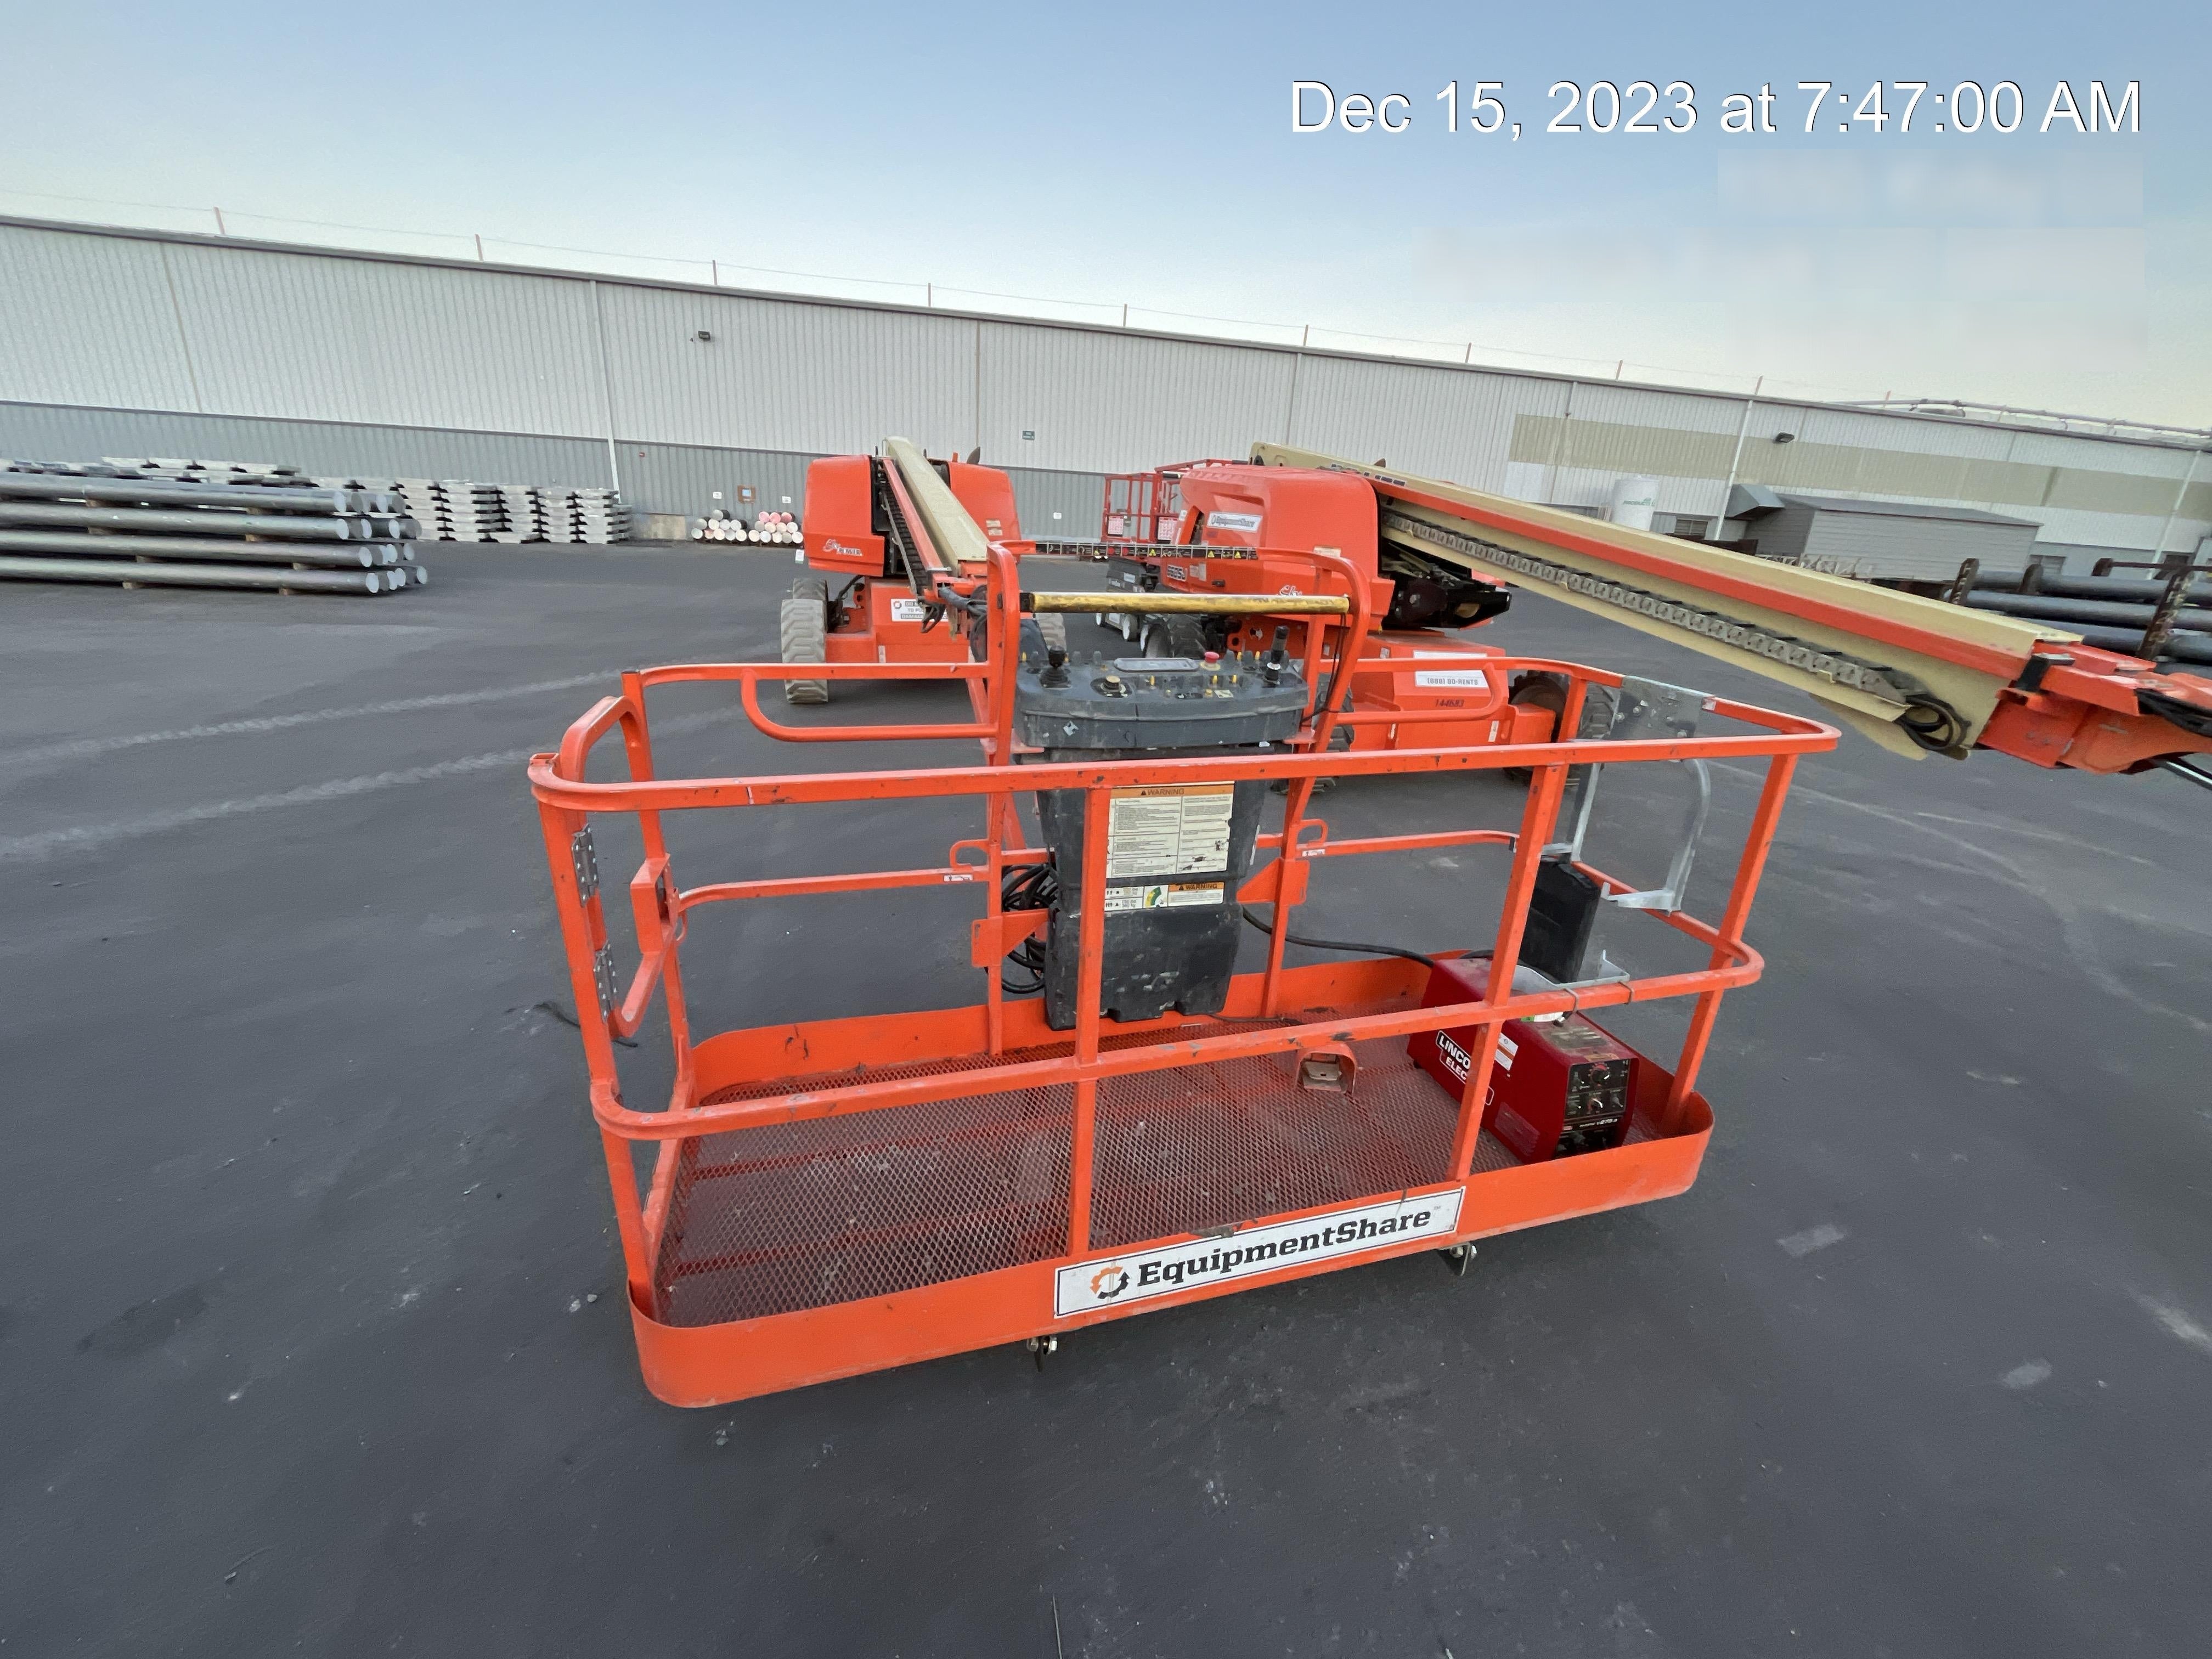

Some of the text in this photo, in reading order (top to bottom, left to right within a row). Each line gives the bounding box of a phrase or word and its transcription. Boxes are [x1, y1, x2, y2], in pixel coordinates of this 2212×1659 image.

[1439, 1035, 1471, 1069] LINCO
[1446, 1056, 1468, 1080] ELEC
[1137, 1210, 1431, 1287] EquipmentShare
